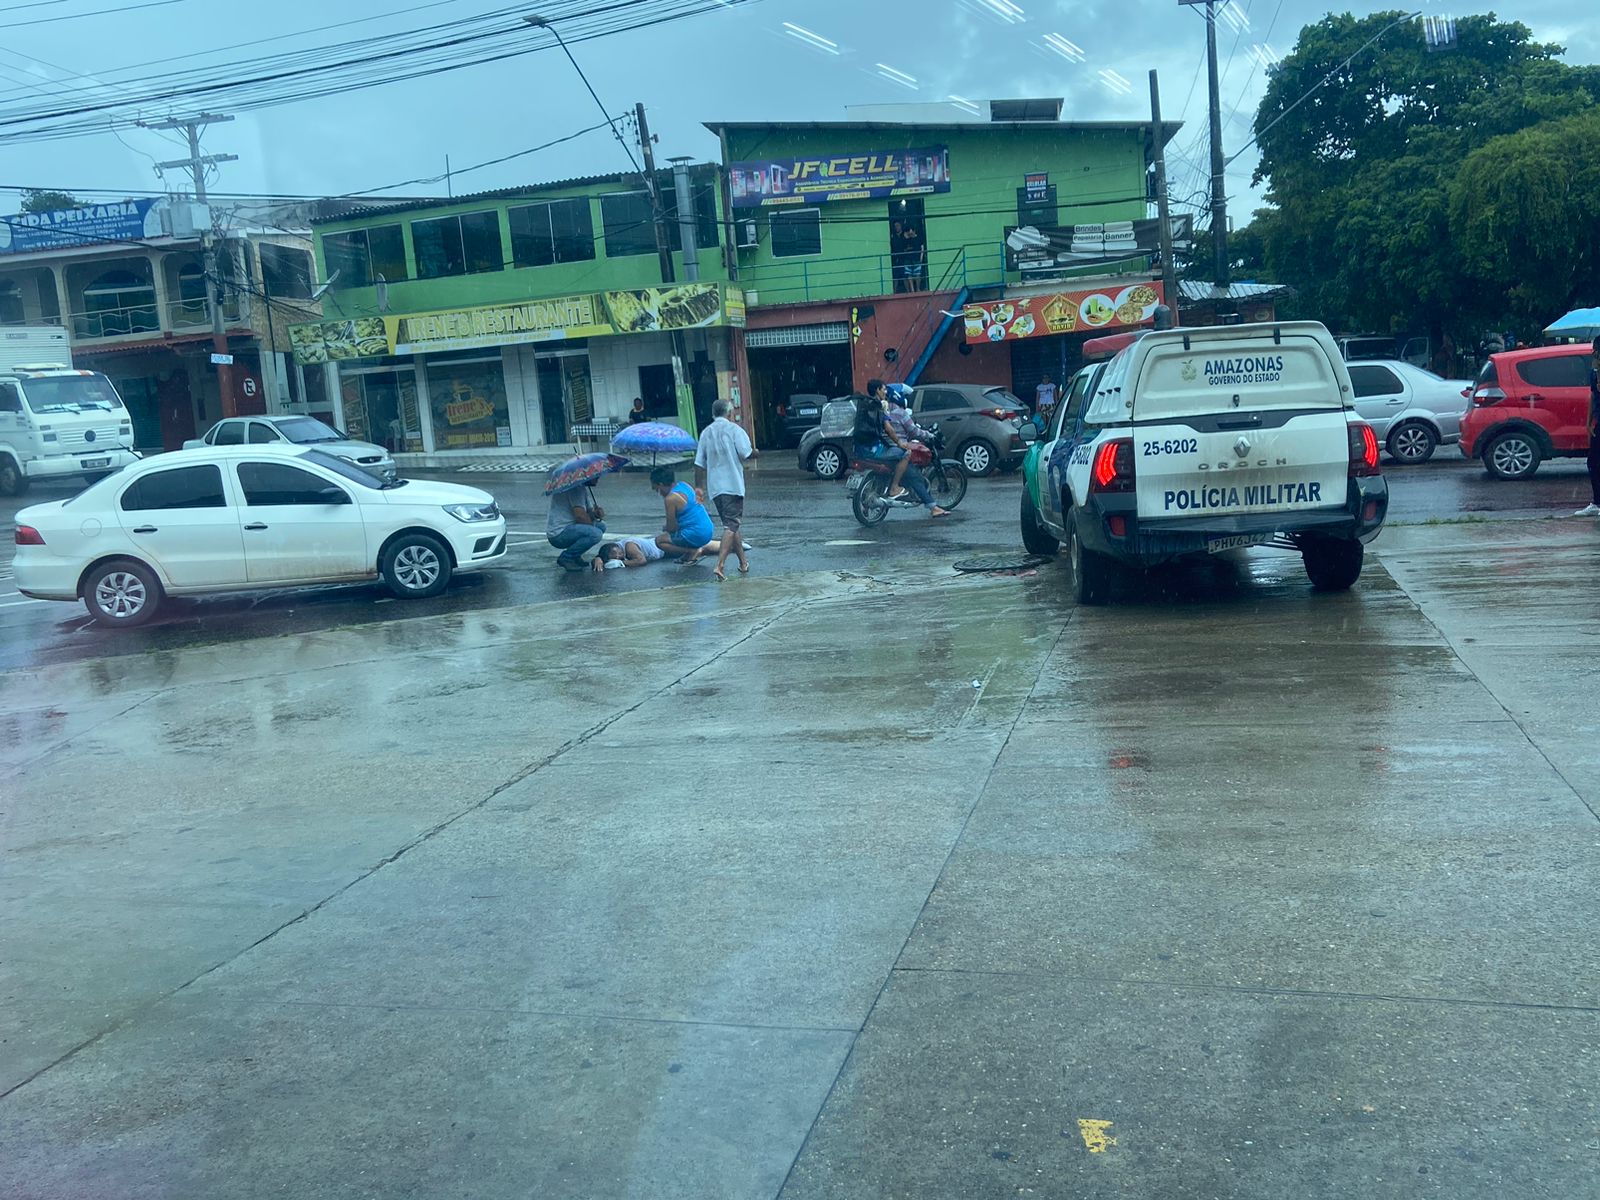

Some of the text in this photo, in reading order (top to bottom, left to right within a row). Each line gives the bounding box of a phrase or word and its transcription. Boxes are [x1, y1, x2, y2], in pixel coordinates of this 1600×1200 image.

[828, 155, 899, 177] CELL
[54, 203, 138, 223] PEIXARIA
[1105, 232, 1133, 240] Banner
[407, 301, 591, 340] IRENE'S RESTAURANTE
[1204, 355, 1283, 375] AMAZONAS
[1208, 372, 1280, 385] GOVERNO DO ESTADO
[1143, 439, 1197, 456] 25-6202
[1198, 458, 1287, 470] OROCH
[1165, 482, 1322, 510] POLÍCIA MILITAR
